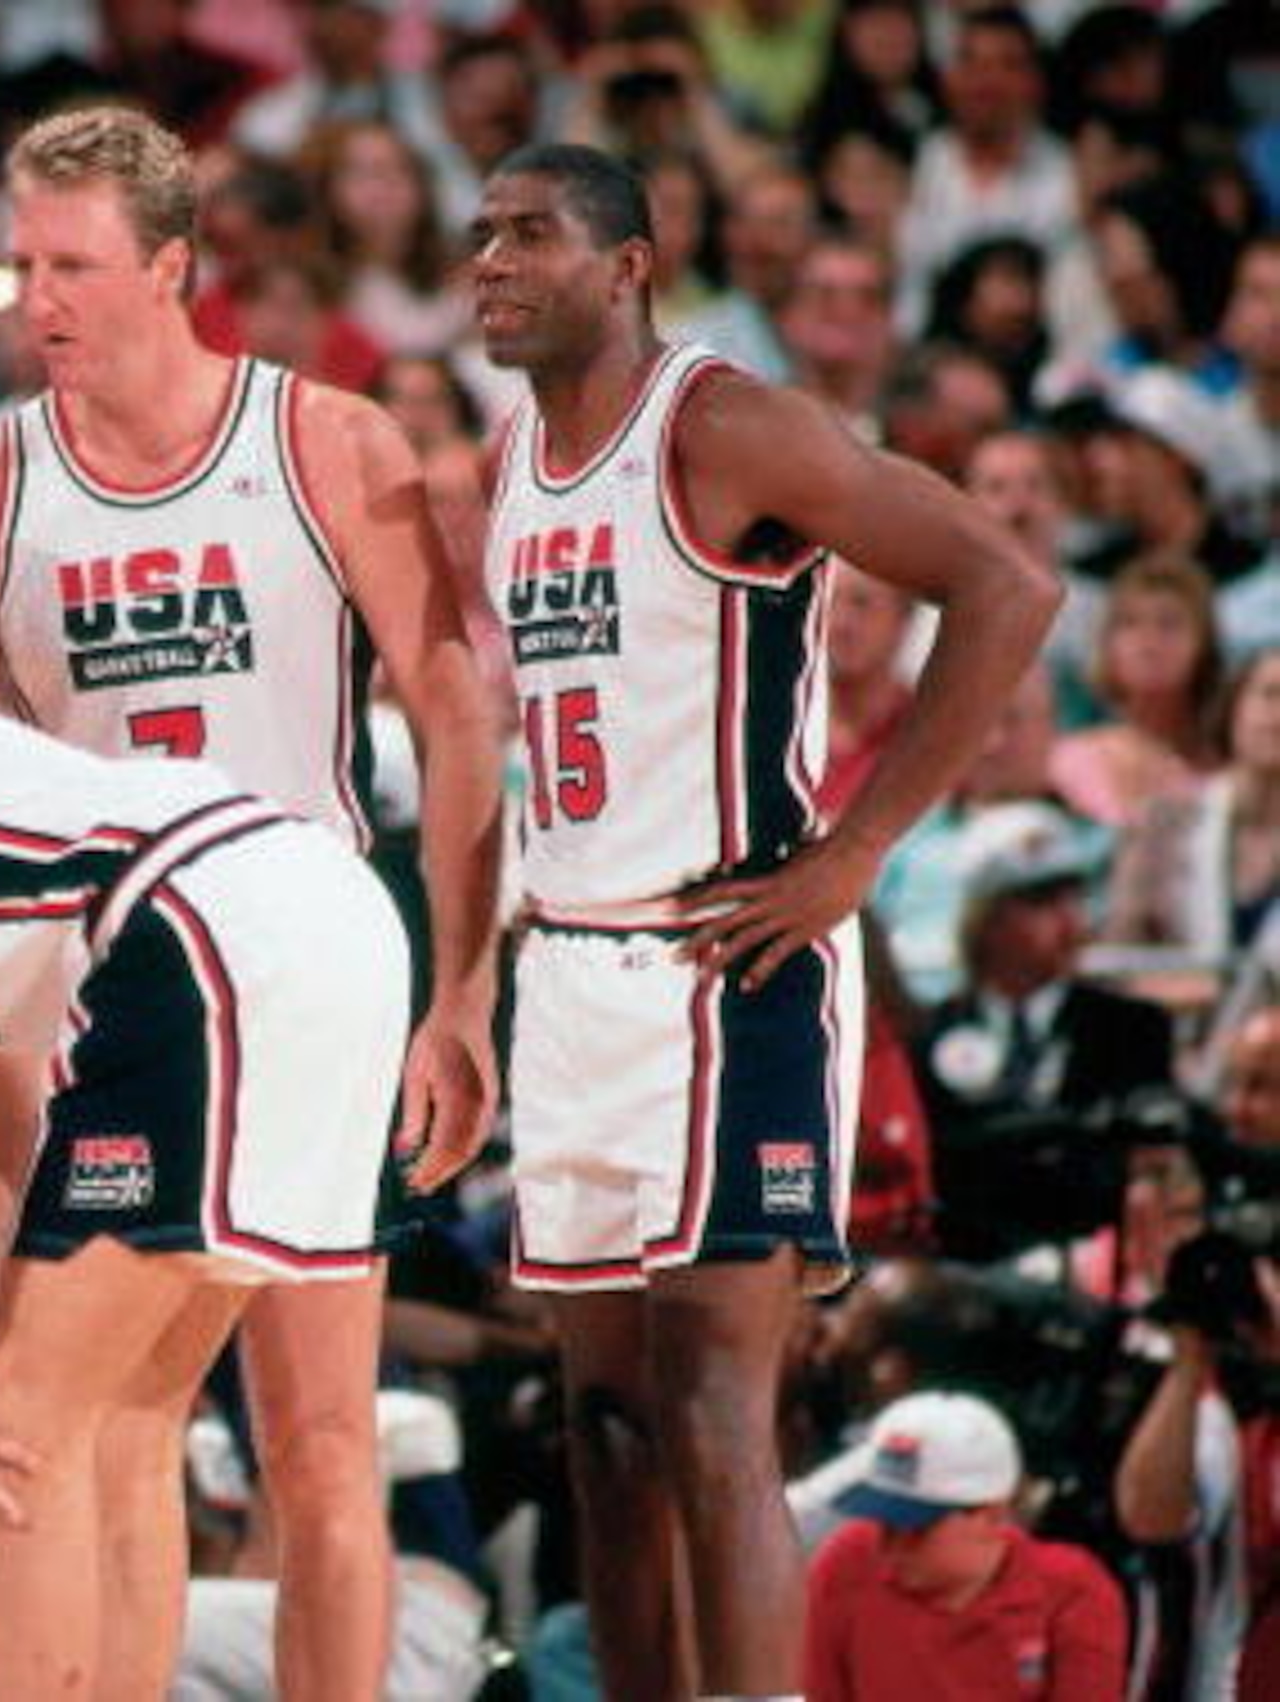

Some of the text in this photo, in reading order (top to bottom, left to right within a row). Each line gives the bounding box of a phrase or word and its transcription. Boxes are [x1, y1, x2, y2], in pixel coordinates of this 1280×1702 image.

[58, 544, 249, 646] USA
[509, 525, 616, 620] USA
[524, 686, 608, 830] 15
